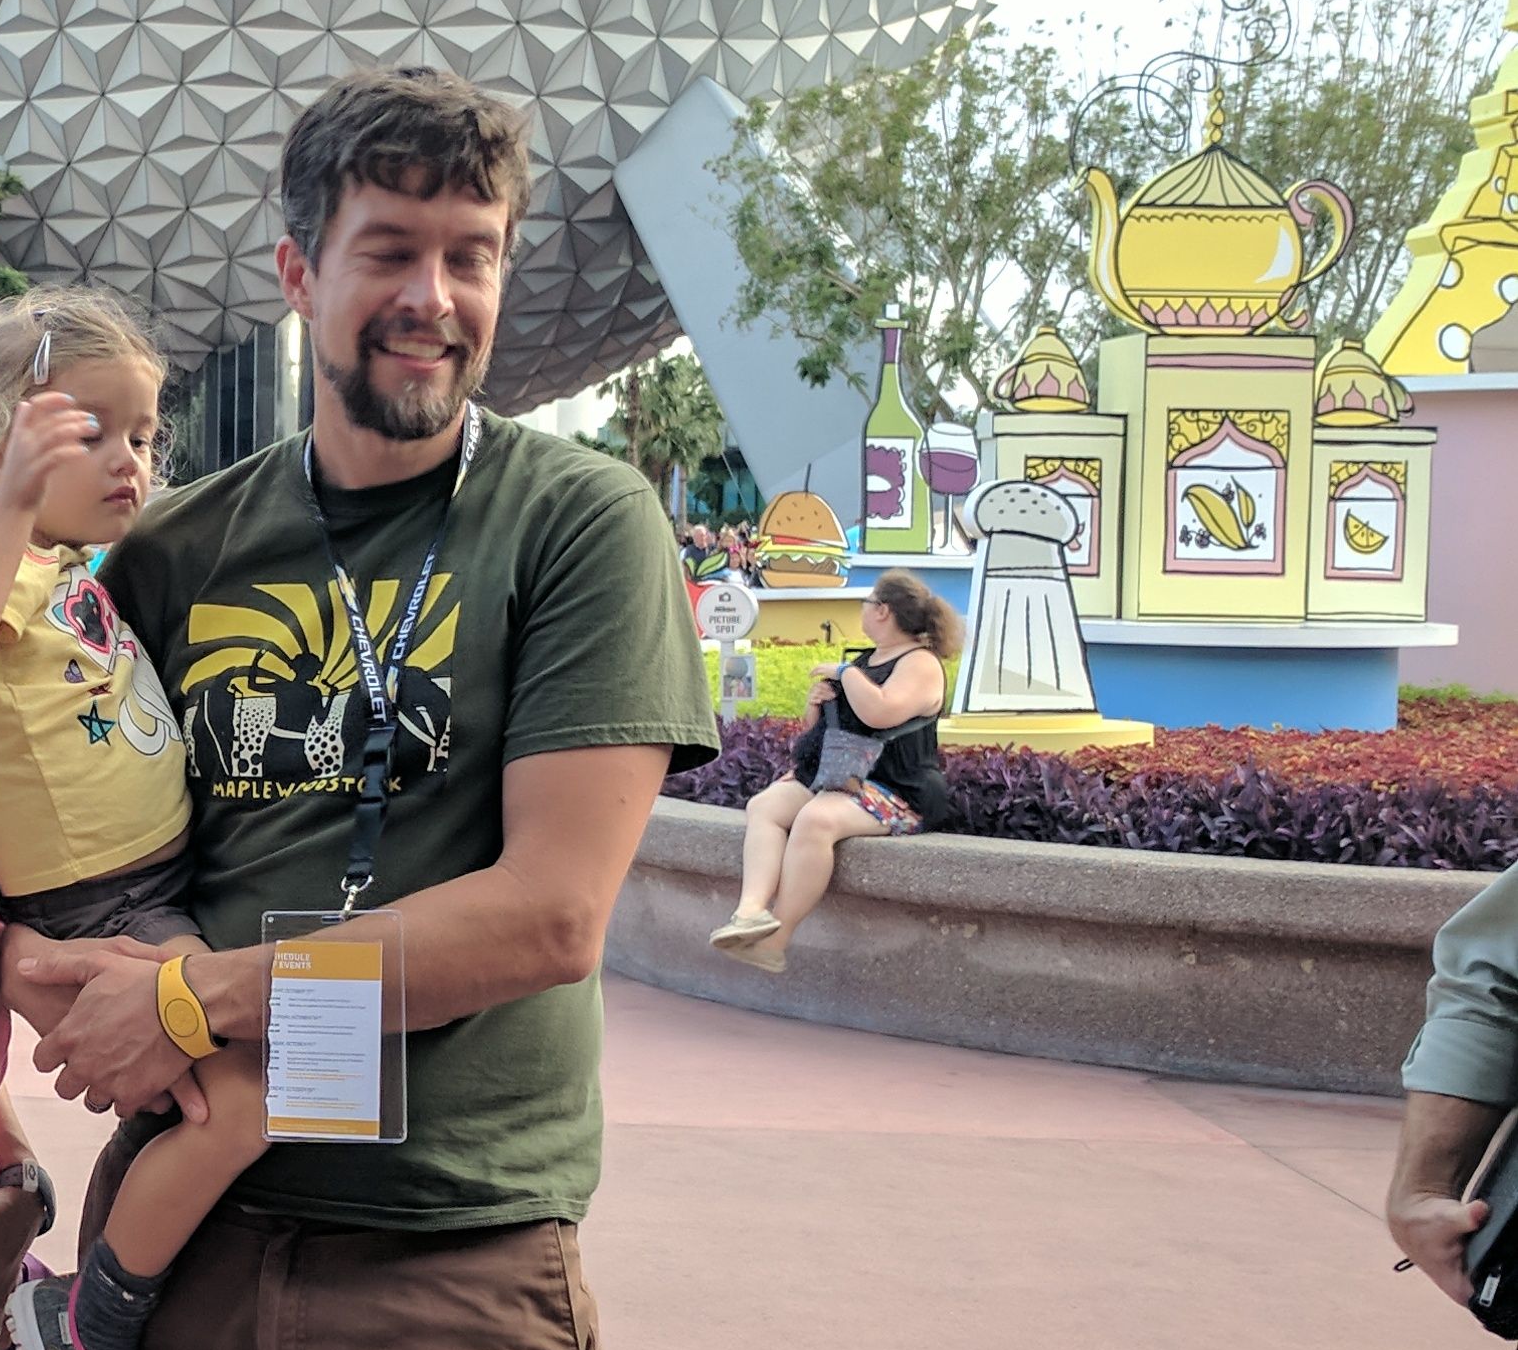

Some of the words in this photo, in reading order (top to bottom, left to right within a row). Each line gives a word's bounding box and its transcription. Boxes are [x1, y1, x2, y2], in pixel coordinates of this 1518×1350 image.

[392, 553, 435, 660] CHEVROLET
[709, 616, 741, 625] PICTURE
[716, 626, 735, 634] SPOT
[352, 615, 386, 723] CHEVROLET
